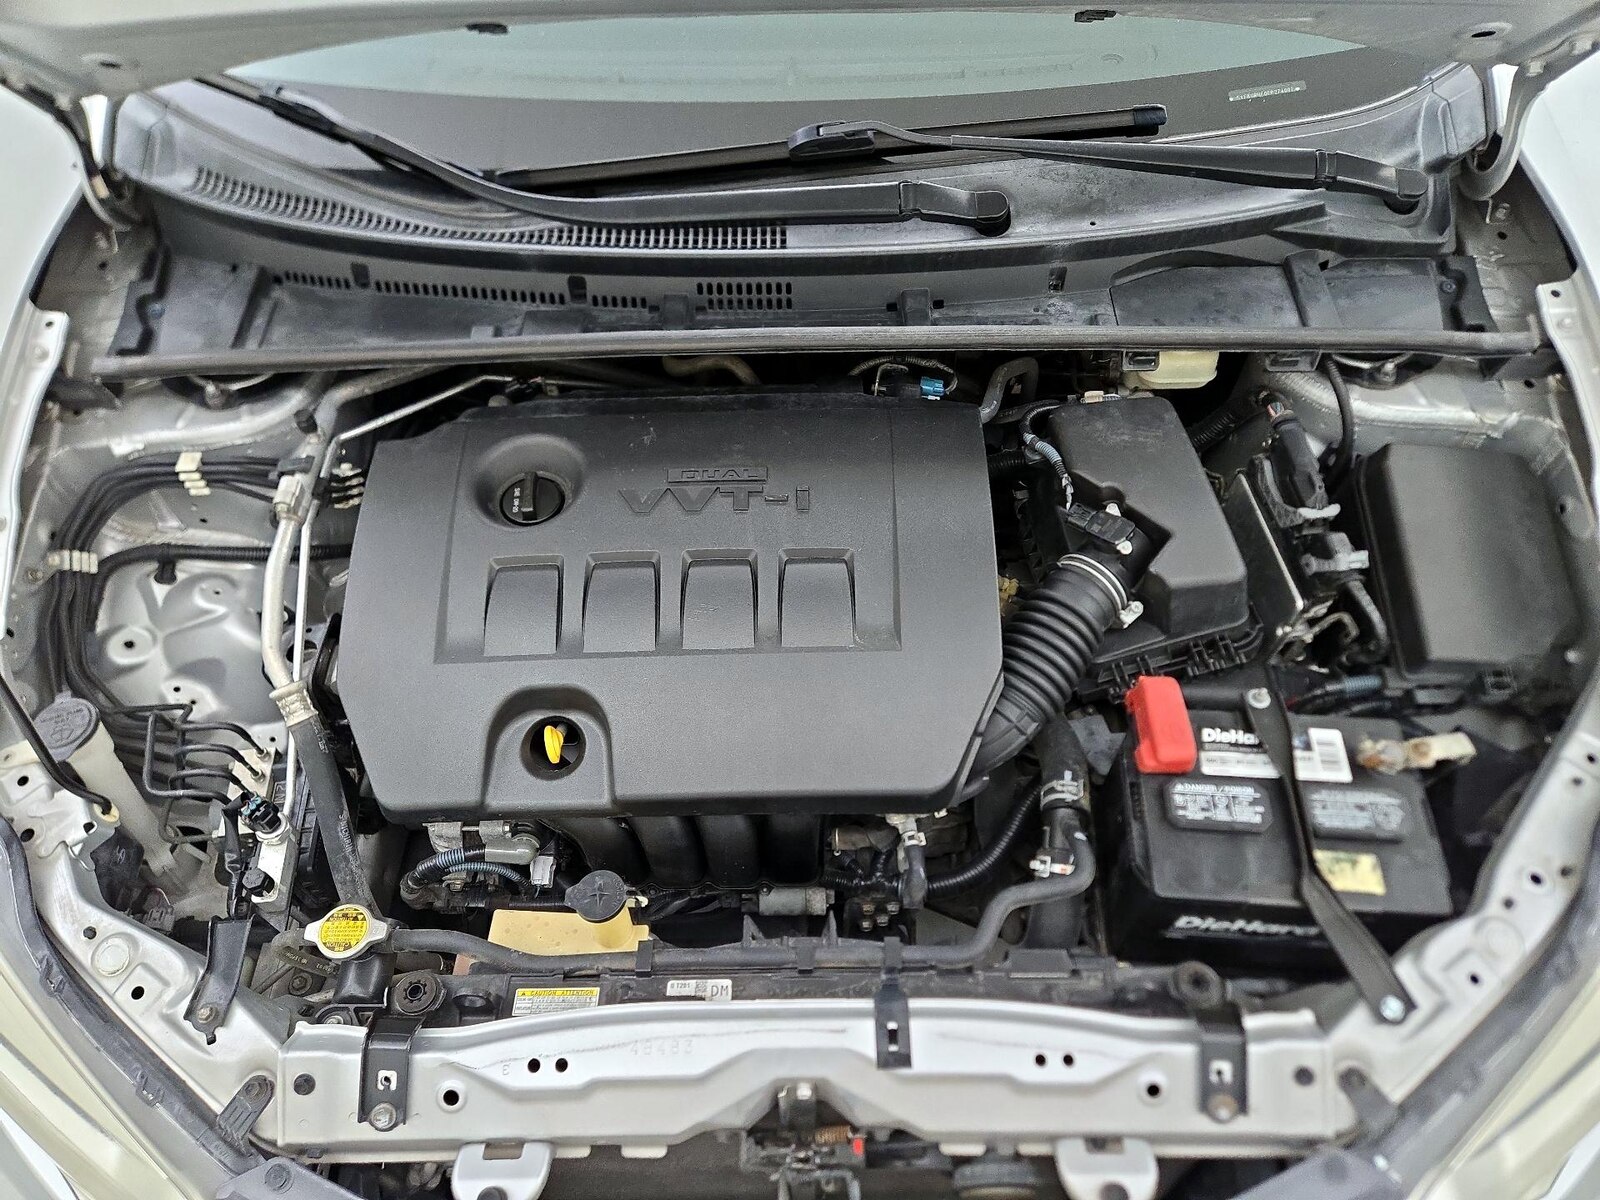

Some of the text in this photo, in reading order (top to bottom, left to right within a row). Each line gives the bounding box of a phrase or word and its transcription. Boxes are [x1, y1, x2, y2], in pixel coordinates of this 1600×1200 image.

[680, 468, 759, 479] DUAL
[560, 989, 594, 997] ATTENTION
[711, 984, 729, 997] DM
